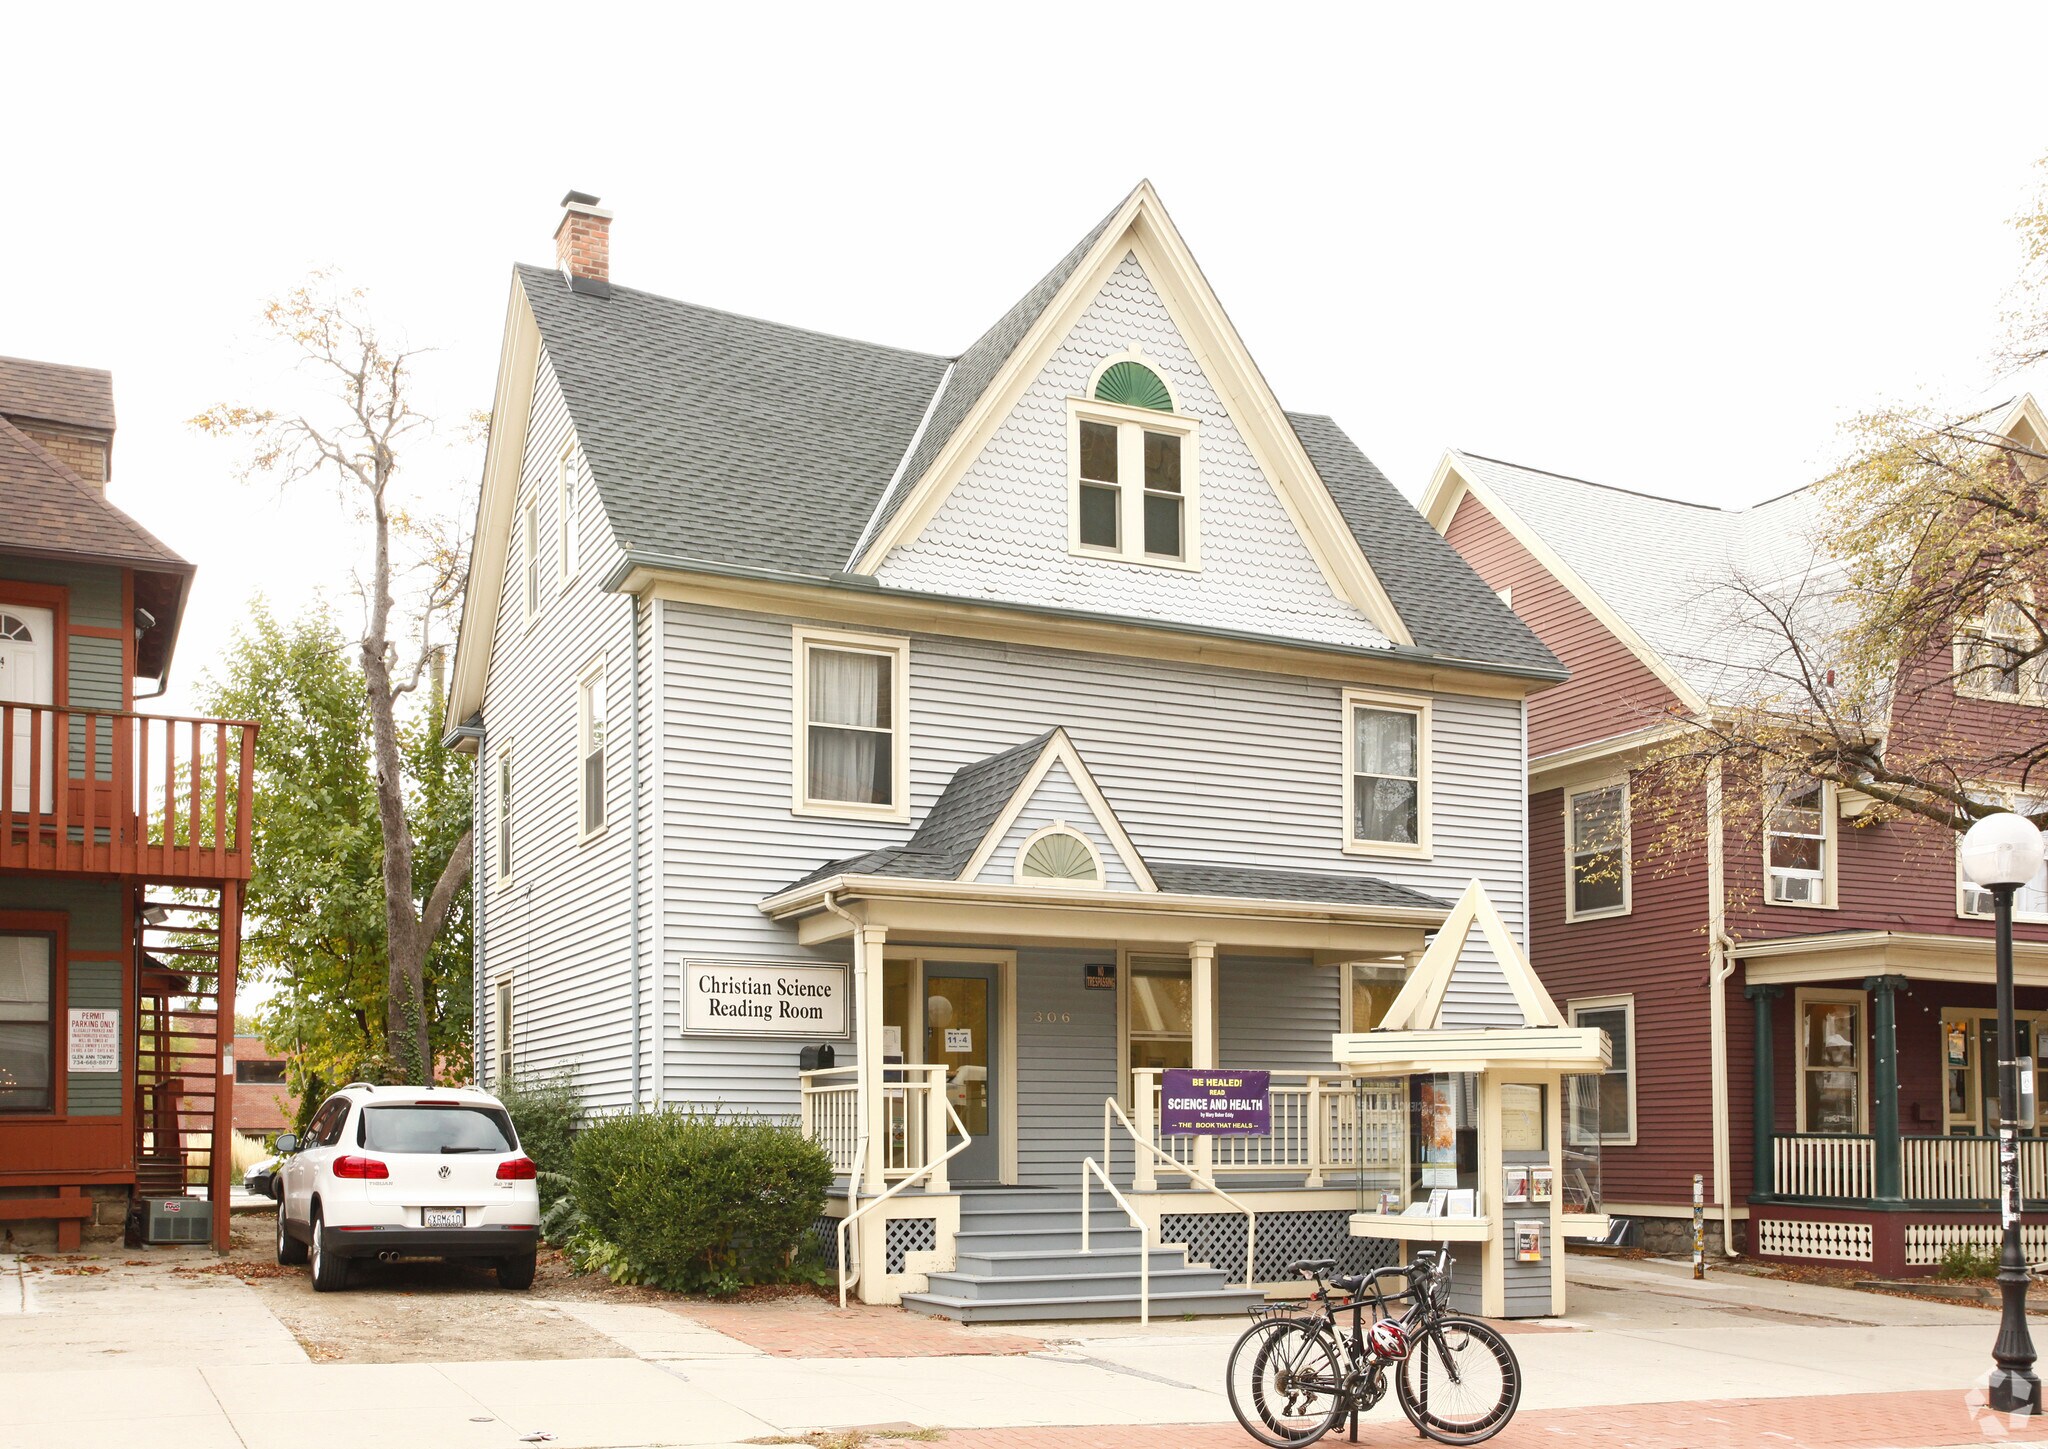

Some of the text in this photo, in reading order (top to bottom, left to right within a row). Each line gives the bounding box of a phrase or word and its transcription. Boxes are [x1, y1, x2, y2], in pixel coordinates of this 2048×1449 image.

[1098, 966, 1104, 976] NO
[699, 975, 832, 997] Christian Science
[1086, 976, 1116, 987] TRESPASSING
[709, 998, 823, 1021] Reading Room
[1034, 1012, 1070, 1023] 306
[1192, 1078, 1242, 1087] BE HEALED!
[1168, 1098, 1262, 1110] SCIENCE AND HEALTH
